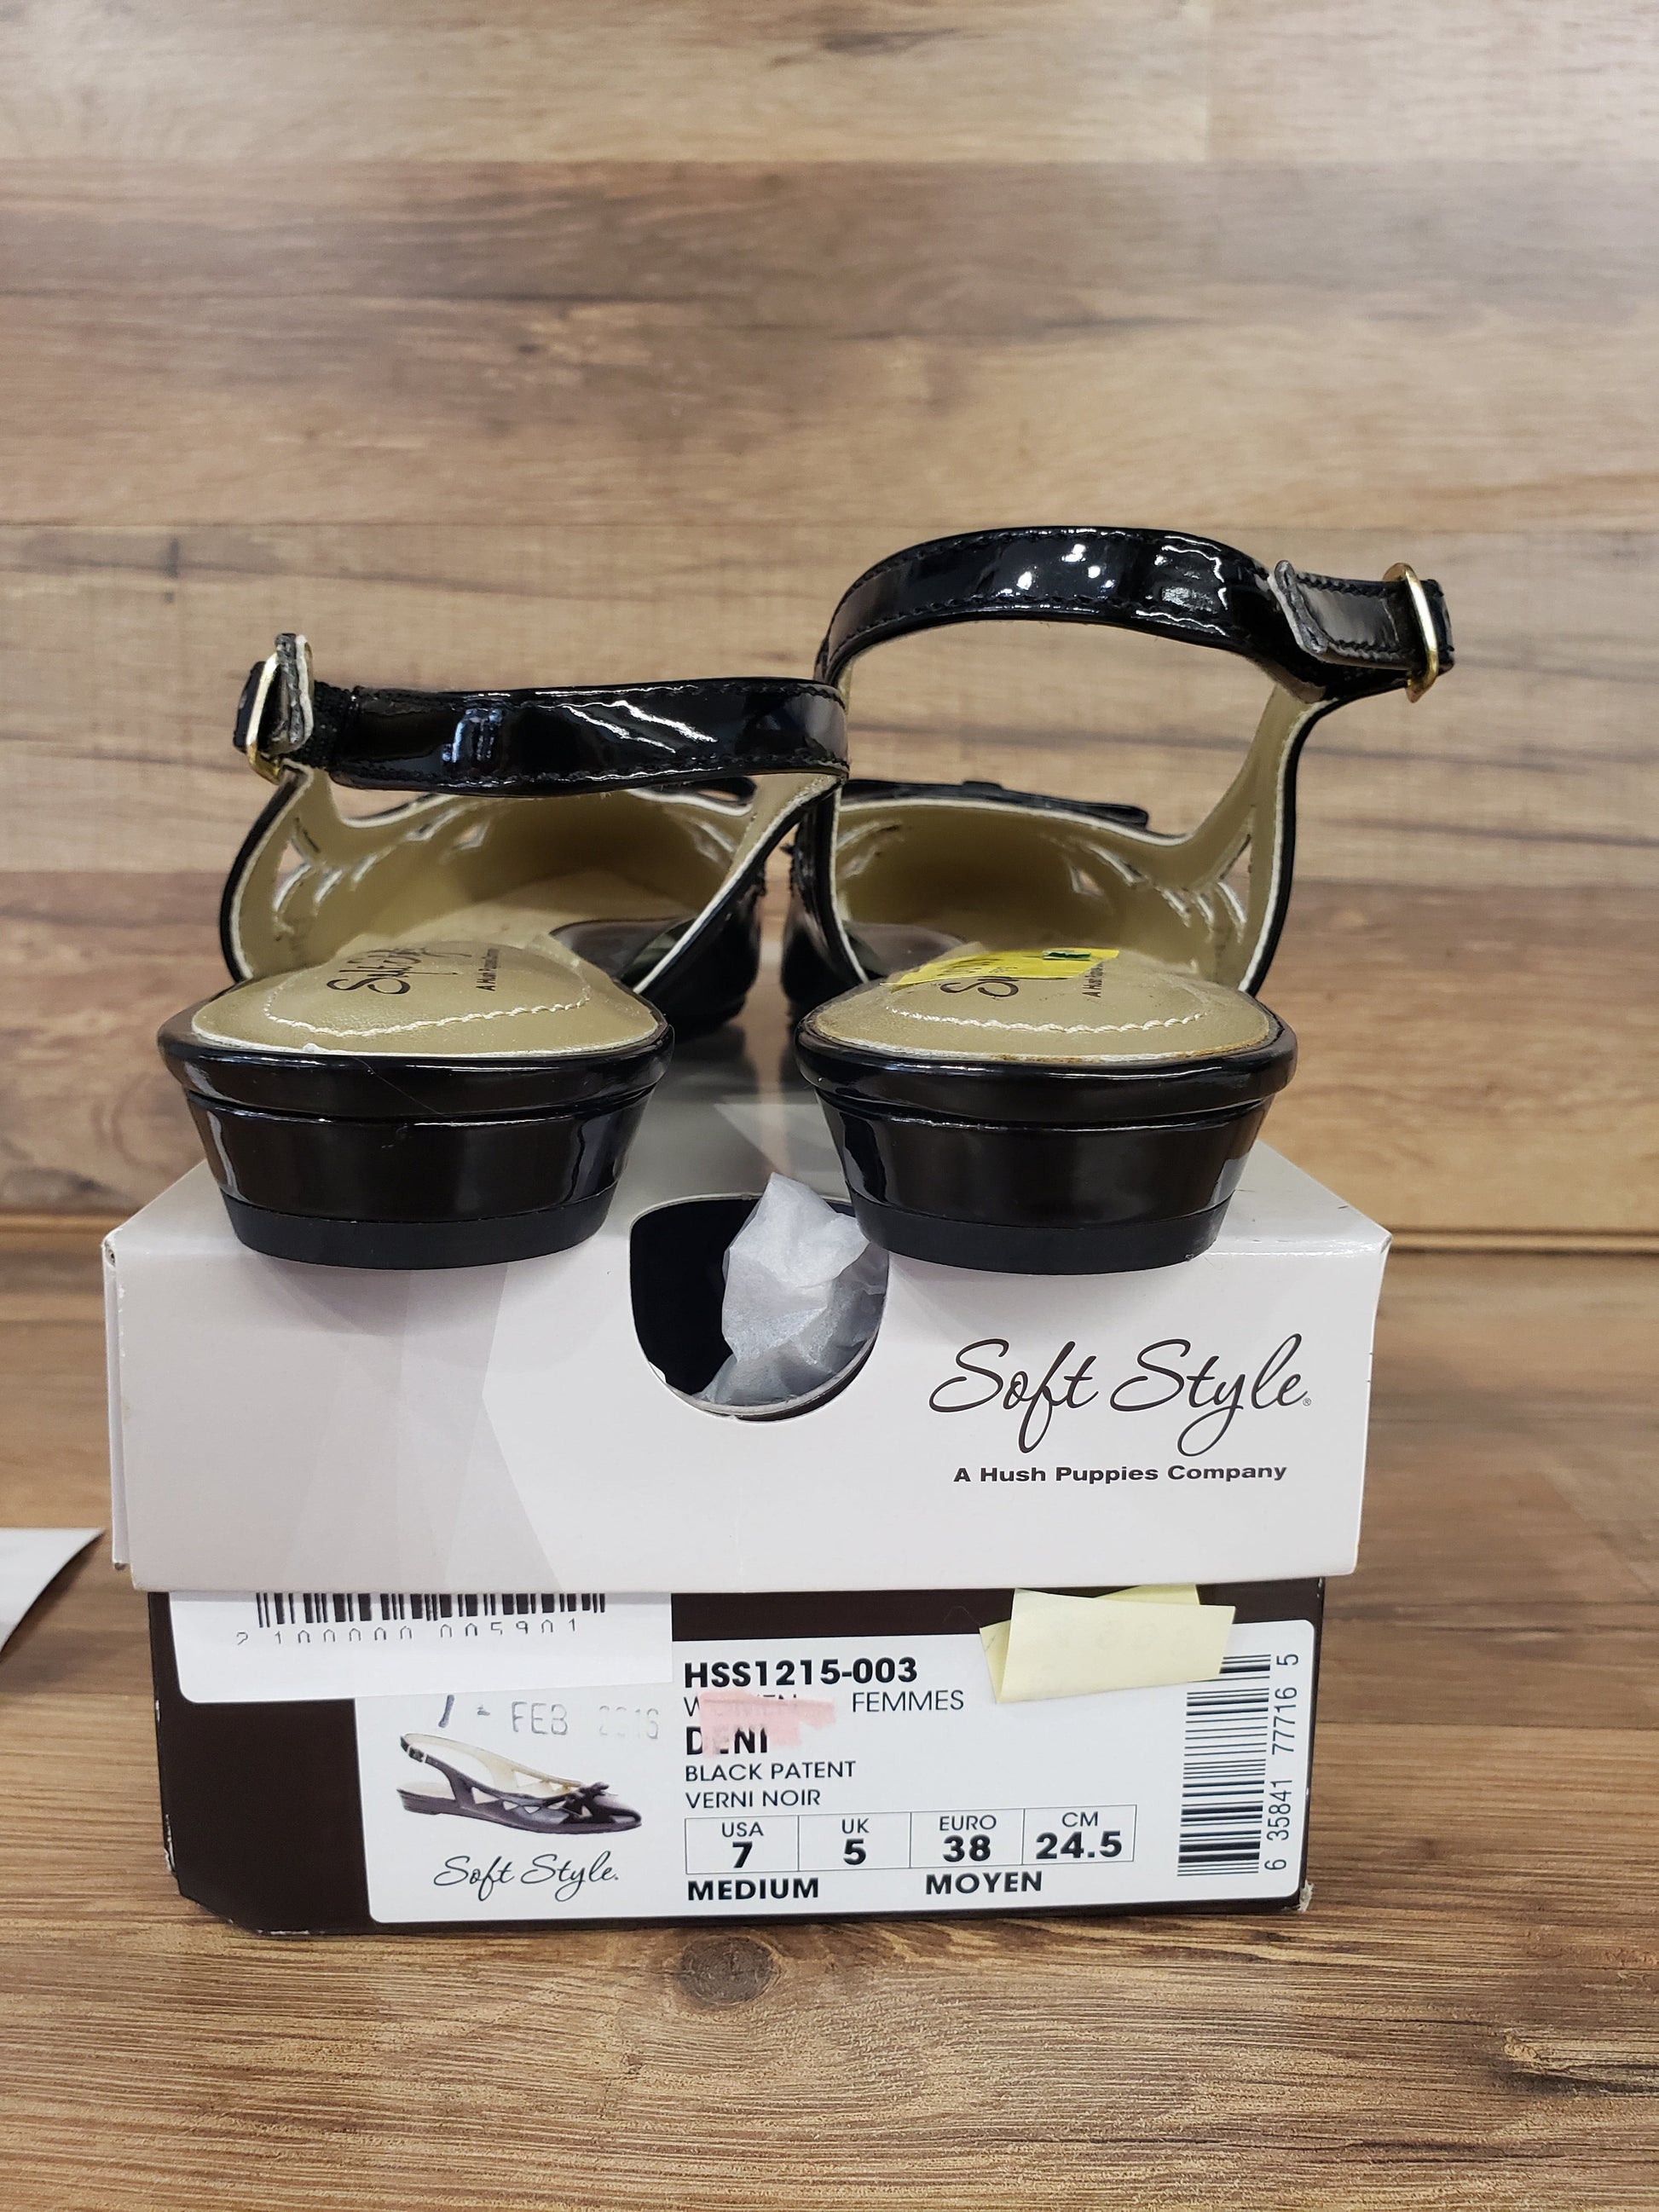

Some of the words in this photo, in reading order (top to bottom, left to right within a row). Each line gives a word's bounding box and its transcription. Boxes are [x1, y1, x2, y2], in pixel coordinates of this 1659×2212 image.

[928, 1337, 1099, 1454] Soft
[953, 1467, 971, 1482] A
[980, 1467, 1046, 1482] Hush
[1055, 1466, 1159, 1485] Puppies
[1167, 1464, 1287, 1482] Company
[1276, 1654, 1299, 1666] 5
[685, 1656, 917, 1689] HSS1215-003
[853, 1689, 964, 1712] FEMMES
[512, 1701, 568, 1736] FEB
[1271, 1687, 1298, 1755] 77716
[685, 1725, 768, 1756] DNI
[685, 1763, 762, 1782] BLACK
[771, 1760, 856, 1780] PATENT
[685, 1791, 754, 1809] VERNI
[762, 1789, 821, 1807] NOIR
[1266, 1780, 1292, 1841] 35841
[721, 1822, 764, 1838] USA
[841, 1818, 869, 1834] UK
[939, 1814, 997, 1831] EURO
[1061, 1811, 1098, 1828] CM
[732, 1841, 753, 1868] 7
[844, 1839, 866, 1866] 5
[943, 1834, 991, 1863] 38
[1036, 1830, 1122, 1860] 24.5
[1263, 1859, 1287, 1870] 6
[433, 1855, 515, 1902] Soft
[688, 1878, 818, 1901] MEDIUM
[926, 1871, 1042, 1895] MOYEN
